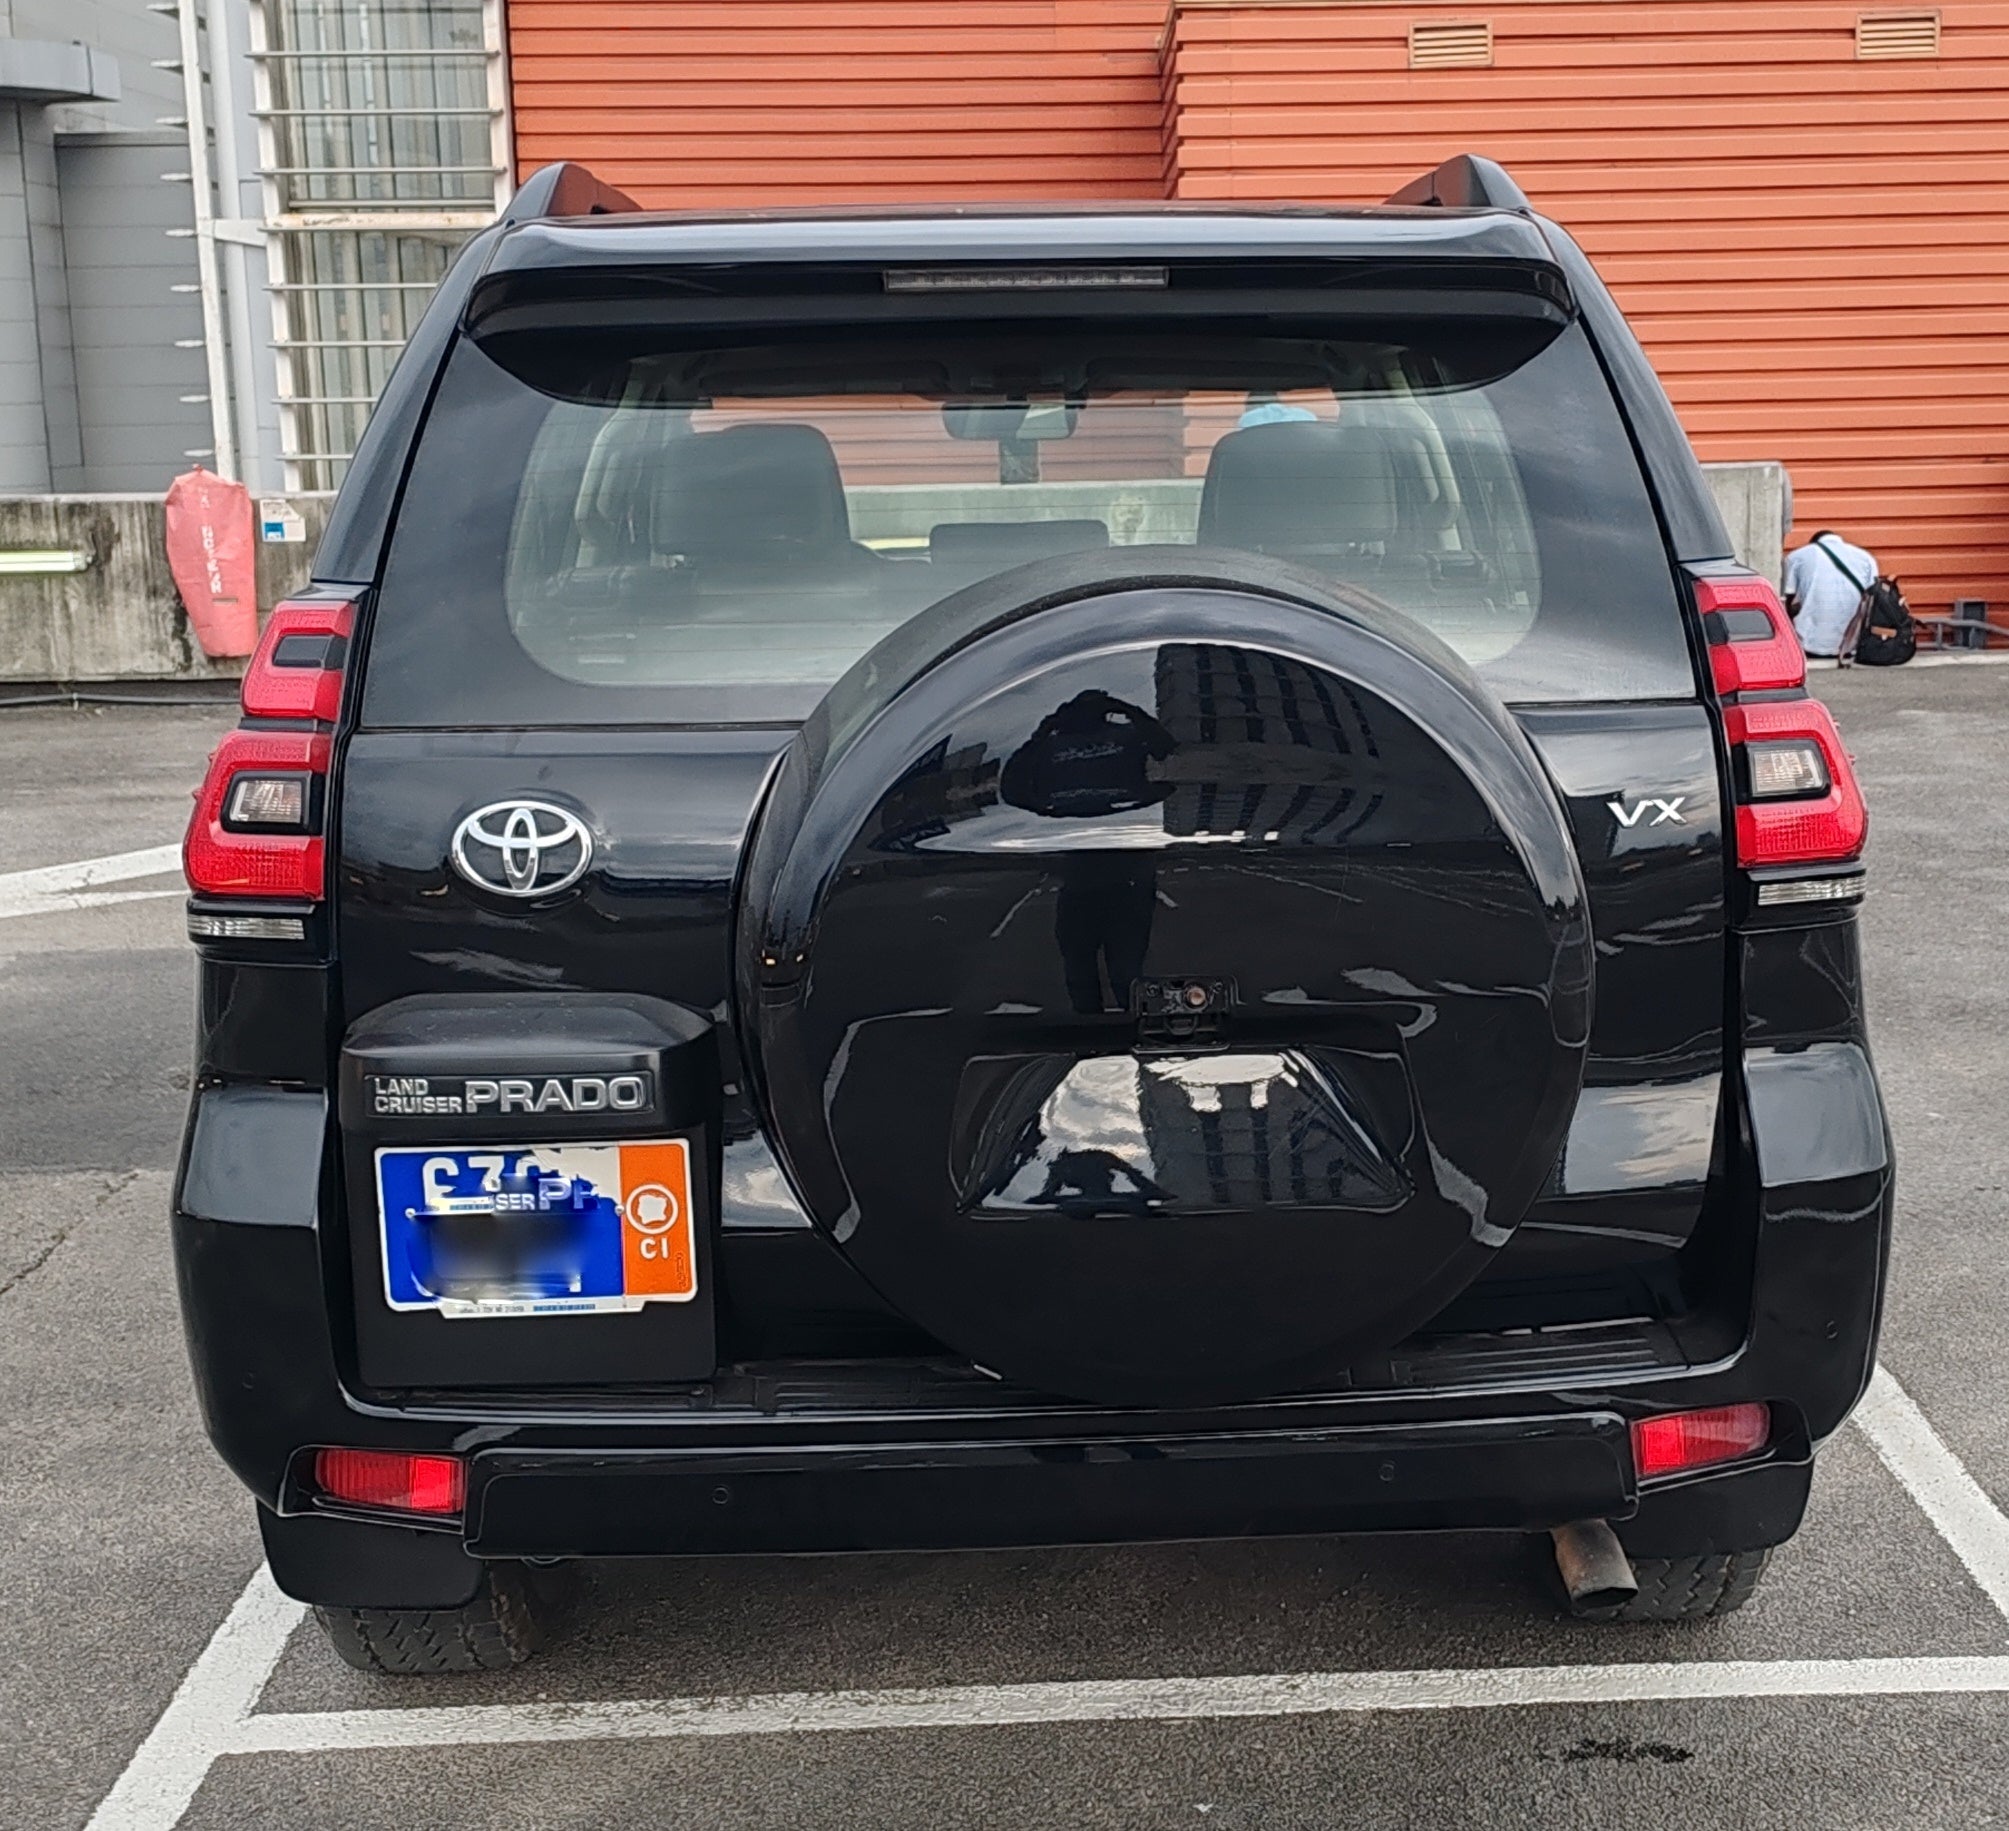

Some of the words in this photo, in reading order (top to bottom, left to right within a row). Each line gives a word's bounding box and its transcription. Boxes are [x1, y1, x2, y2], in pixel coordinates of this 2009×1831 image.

[1606, 796, 1687, 828] VX
[374, 1078, 428, 1095] LAND
[374, 1096, 462, 1113] CRUISER
[465, 1077, 646, 1112] PRADO
[640, 1236, 669, 1260] CI
